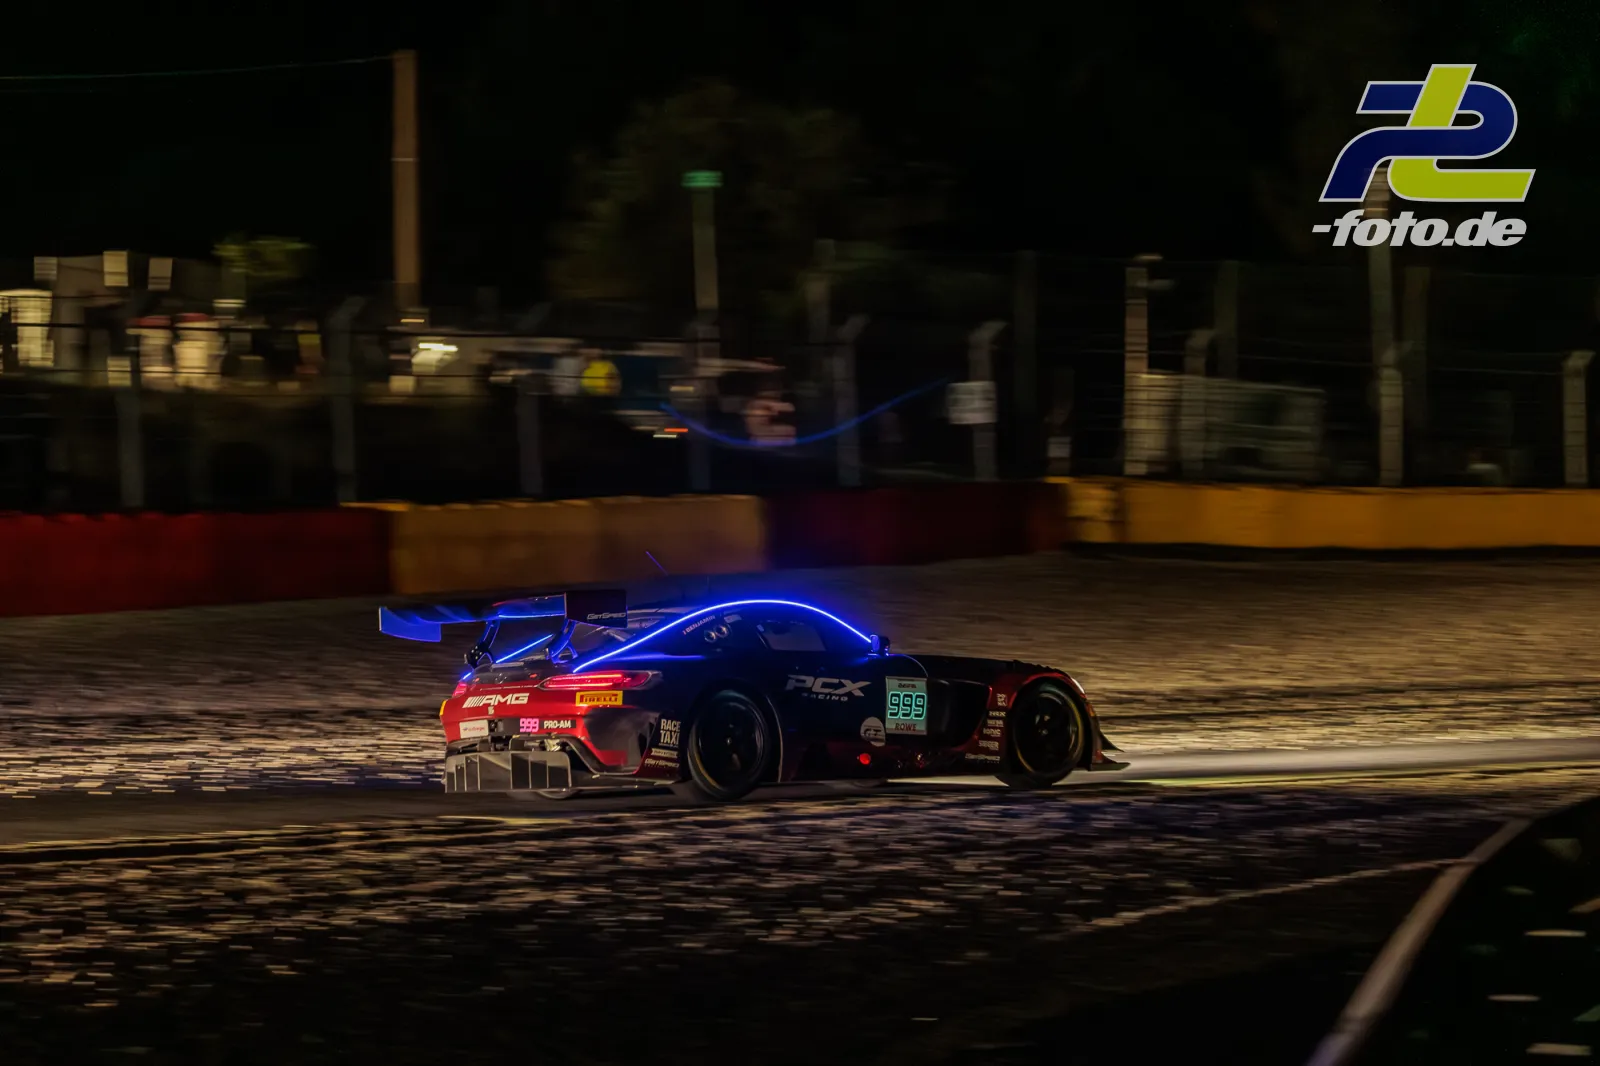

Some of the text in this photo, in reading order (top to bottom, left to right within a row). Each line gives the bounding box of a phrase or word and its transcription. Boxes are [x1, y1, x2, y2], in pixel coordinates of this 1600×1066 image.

[784, 674, 872, 697] PCX
[579, 693, 618, 703] PIRELLI
[888, 691, 927, 720] 999
[519, 717, 540, 732] 999
[543, 720, 572, 730] PRO-AM
[660, 718, 681, 732] RACE
[894, 723, 917, 732] ROWE
[659, 730, 680, 745] TAXI
